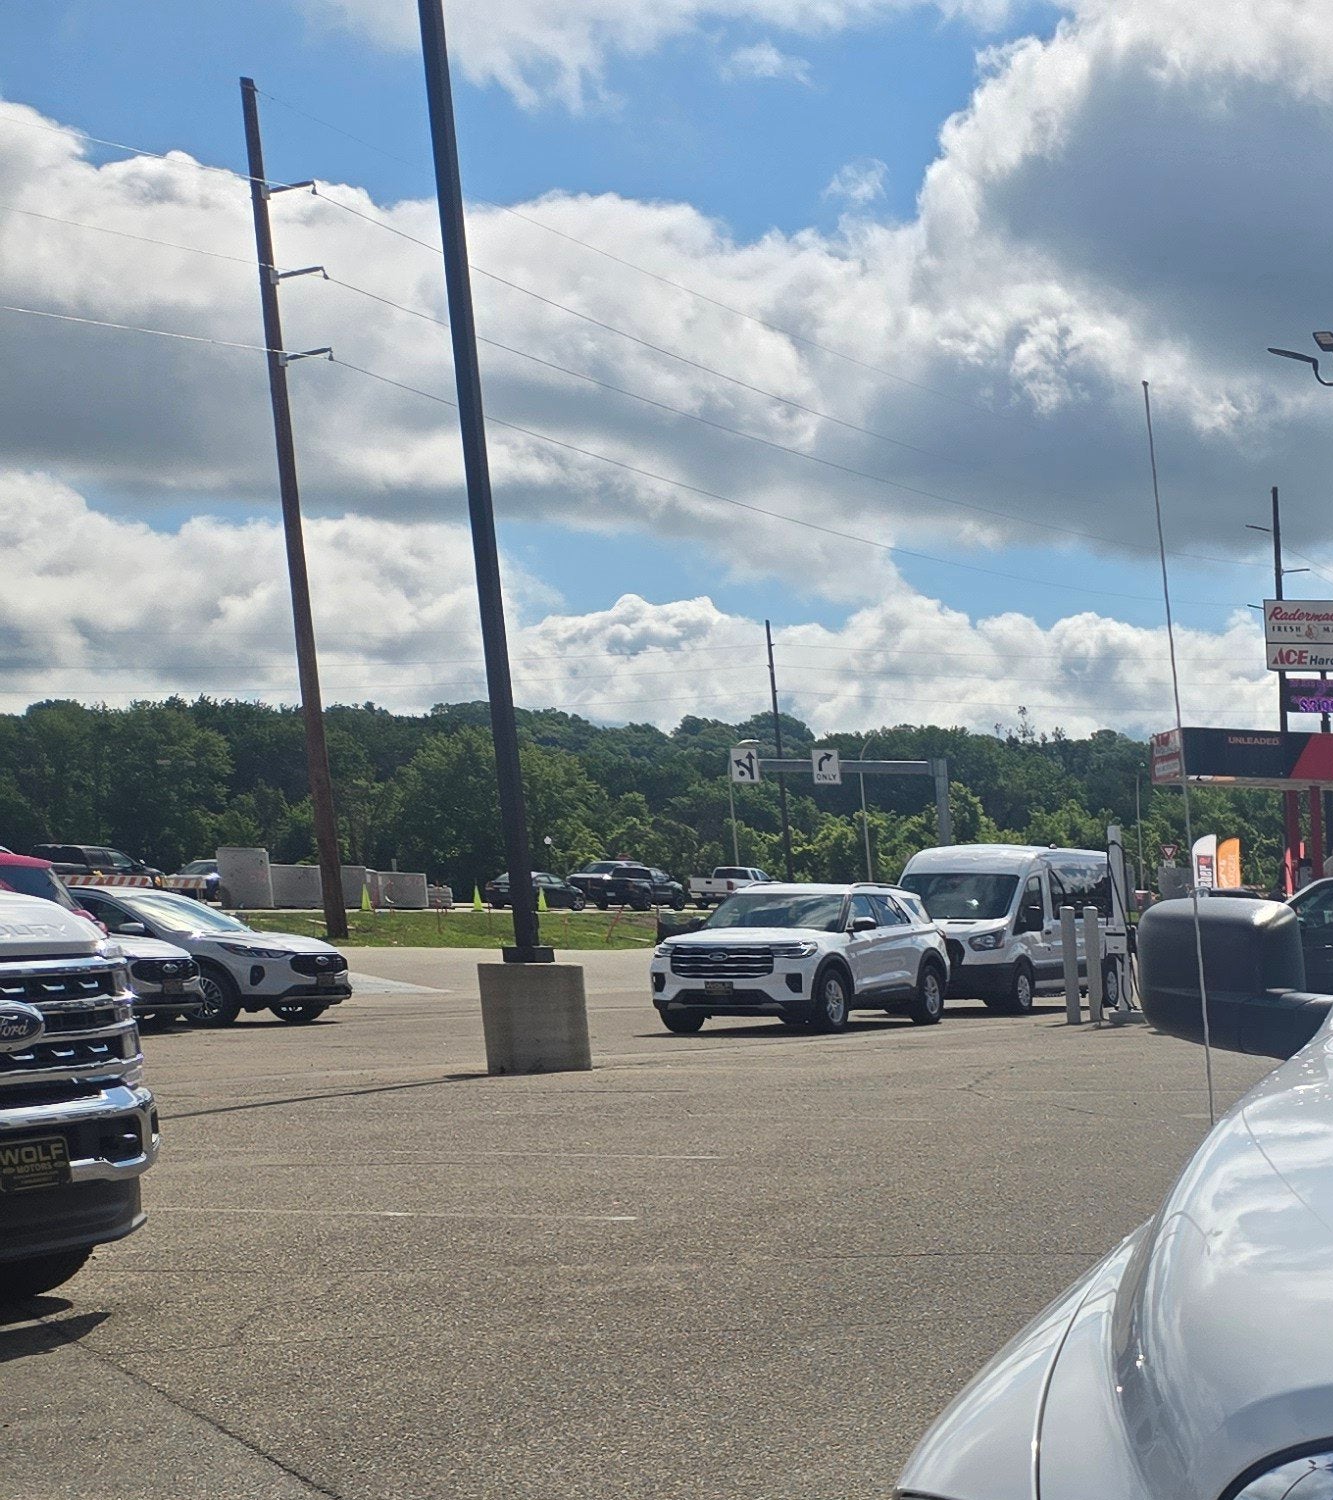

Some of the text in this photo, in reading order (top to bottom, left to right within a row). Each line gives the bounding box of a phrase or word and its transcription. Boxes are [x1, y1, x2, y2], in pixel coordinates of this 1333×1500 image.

[1272, 647, 1309, 665] ACE
[1228, 736, 1280, 746] UNLEADED
[816, 773, 837, 781] ONLY
[0, 1143, 63, 1166] WOLF
